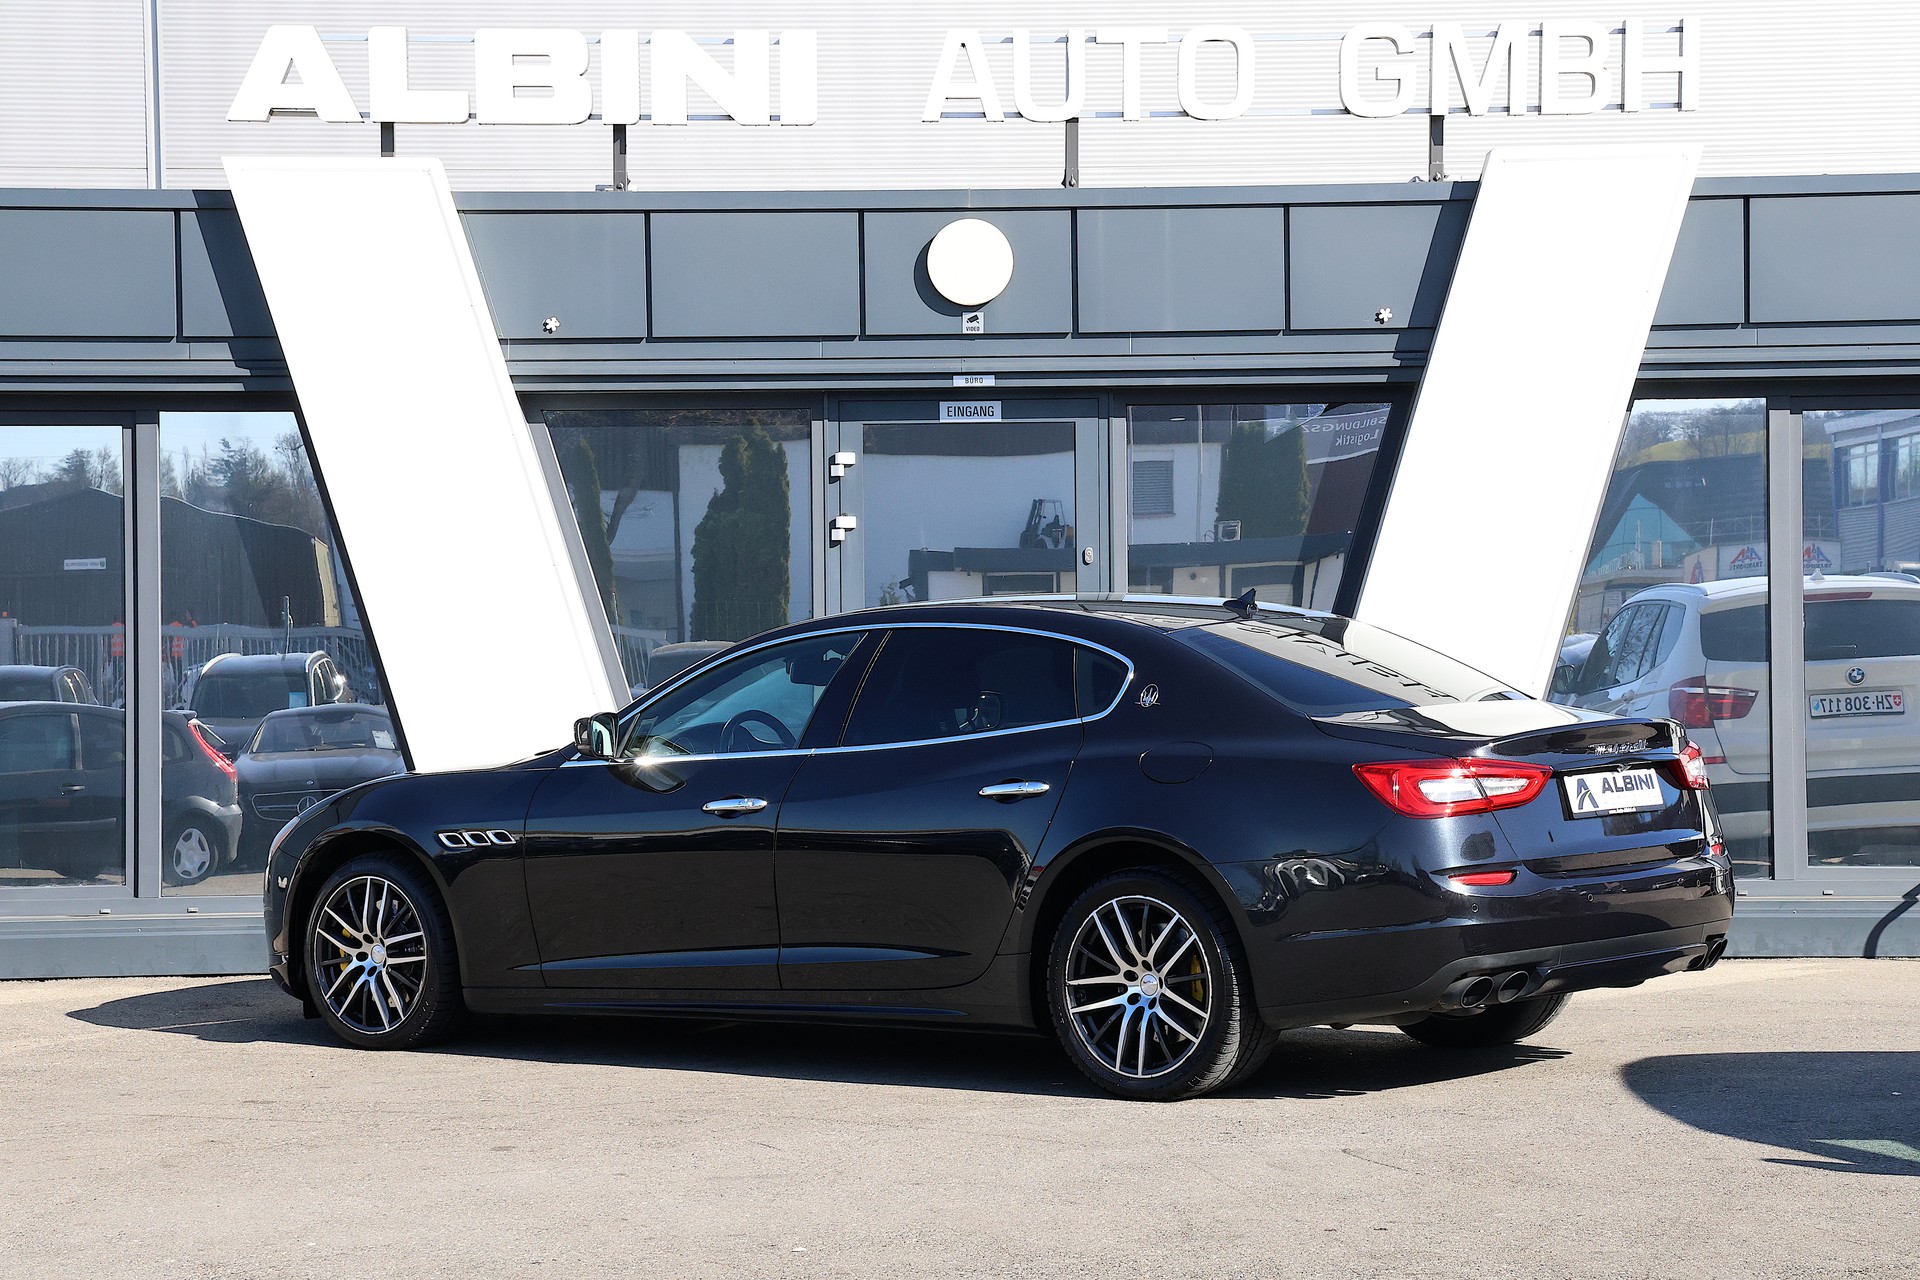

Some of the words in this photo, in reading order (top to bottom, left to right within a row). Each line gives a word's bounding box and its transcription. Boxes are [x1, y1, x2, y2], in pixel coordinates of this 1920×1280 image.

[225, 24, 818, 126] ALBINI
[922, 26, 1256, 123] AUTO
[1339, 17, 1701, 118] GMBH
[964, 376, 984, 384] BÜRO
[947, 405, 995, 417] EINGANG
[1601, 773, 1655, 794] ALBINI
